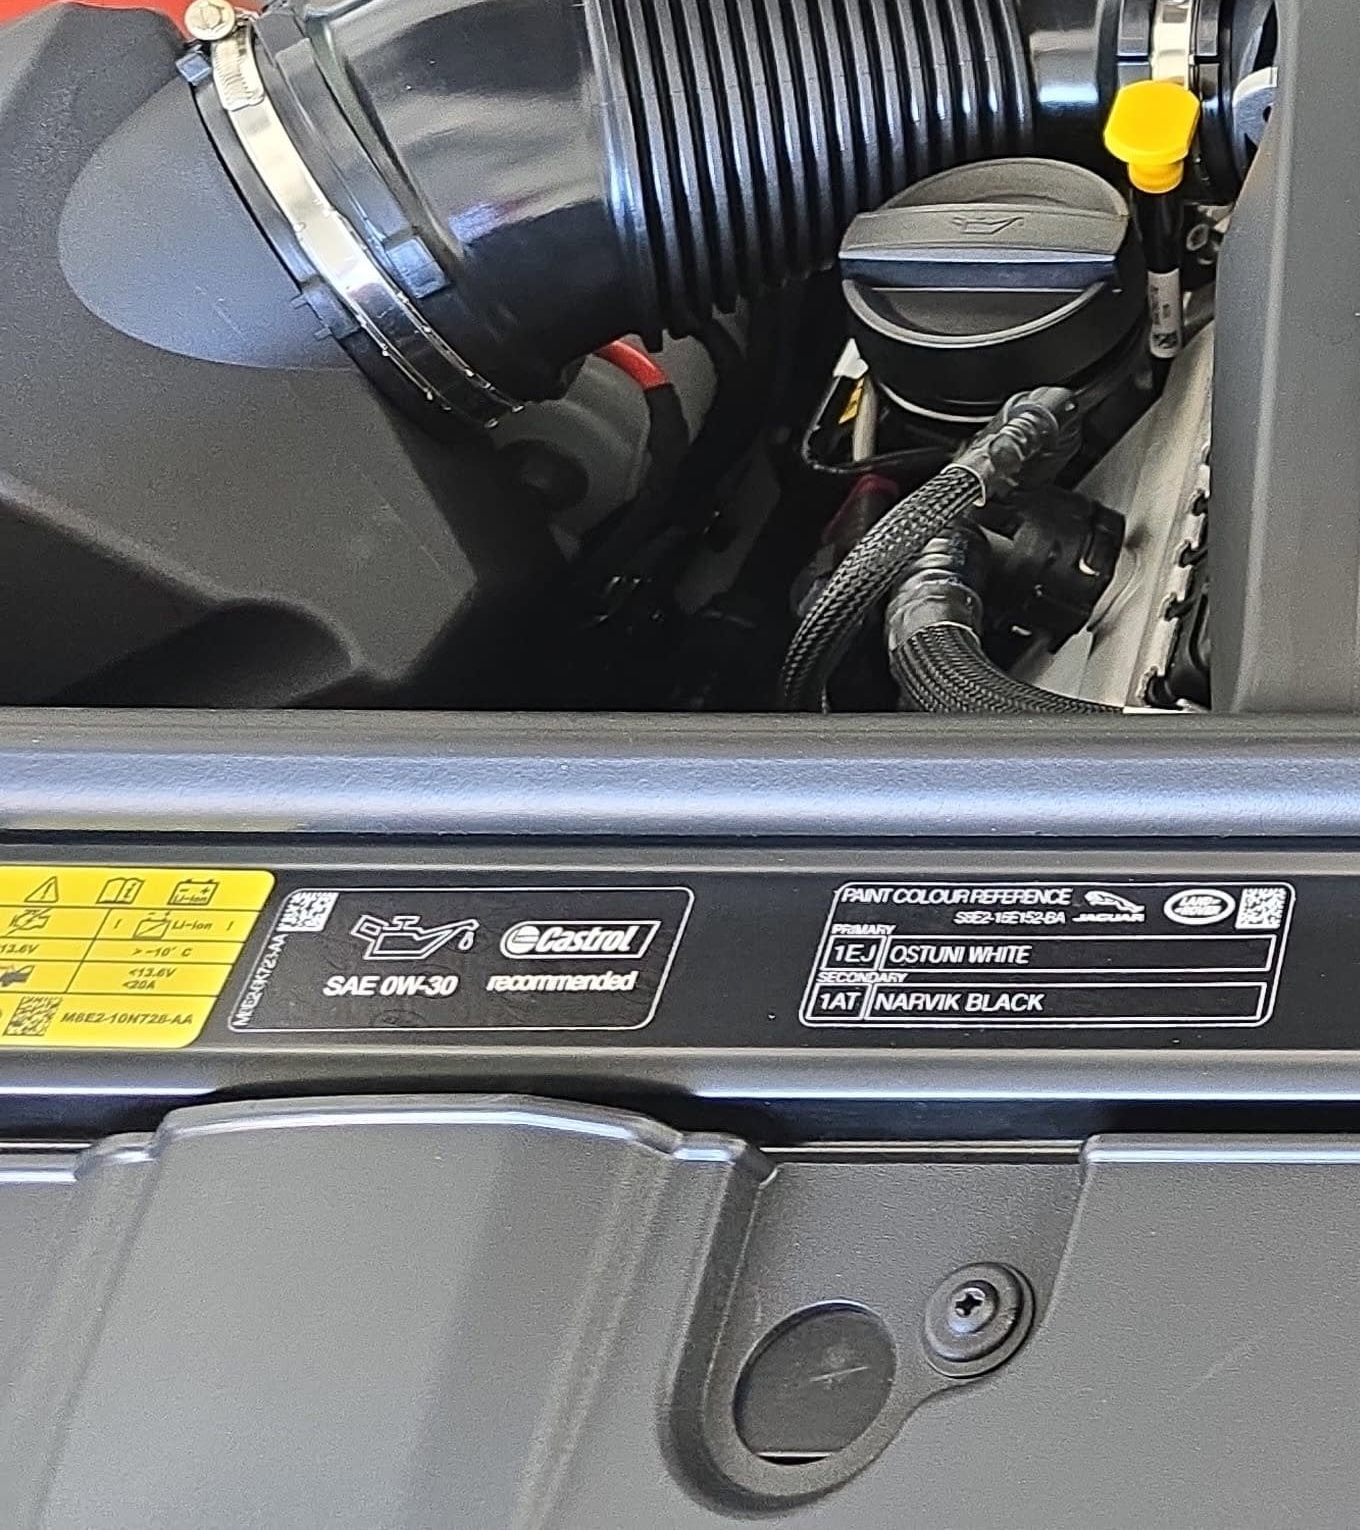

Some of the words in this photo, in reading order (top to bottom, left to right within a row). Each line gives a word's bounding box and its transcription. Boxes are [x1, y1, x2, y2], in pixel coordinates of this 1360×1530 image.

[841, 888, 893, 904] PAINT
[892, 888, 970, 905] COLOUR
[969, 888, 1073, 905] REFERENCE
[171, 919, 213, 930] Li-ion
[1072, 913, 1145, 922] JAGUAR
[831, 924, 896, 935] PRIMARY
[535, 925, 641, 953] Castrol
[834, 944, 877, 963] 1EJ
[889, 945, 965, 964] OSTUNI
[968, 945, 1033, 964] WHITE
[323, 975, 379, 997] SAE
[380, 975, 458, 997] 0W-30
[486, 970, 639, 992] recommended
[816, 972, 908, 983] SECONDARY
[819, 992, 862, 1011] 1AT
[873, 992, 962, 1011] NARVIK
[964, 992, 1046, 1012] BLACK
